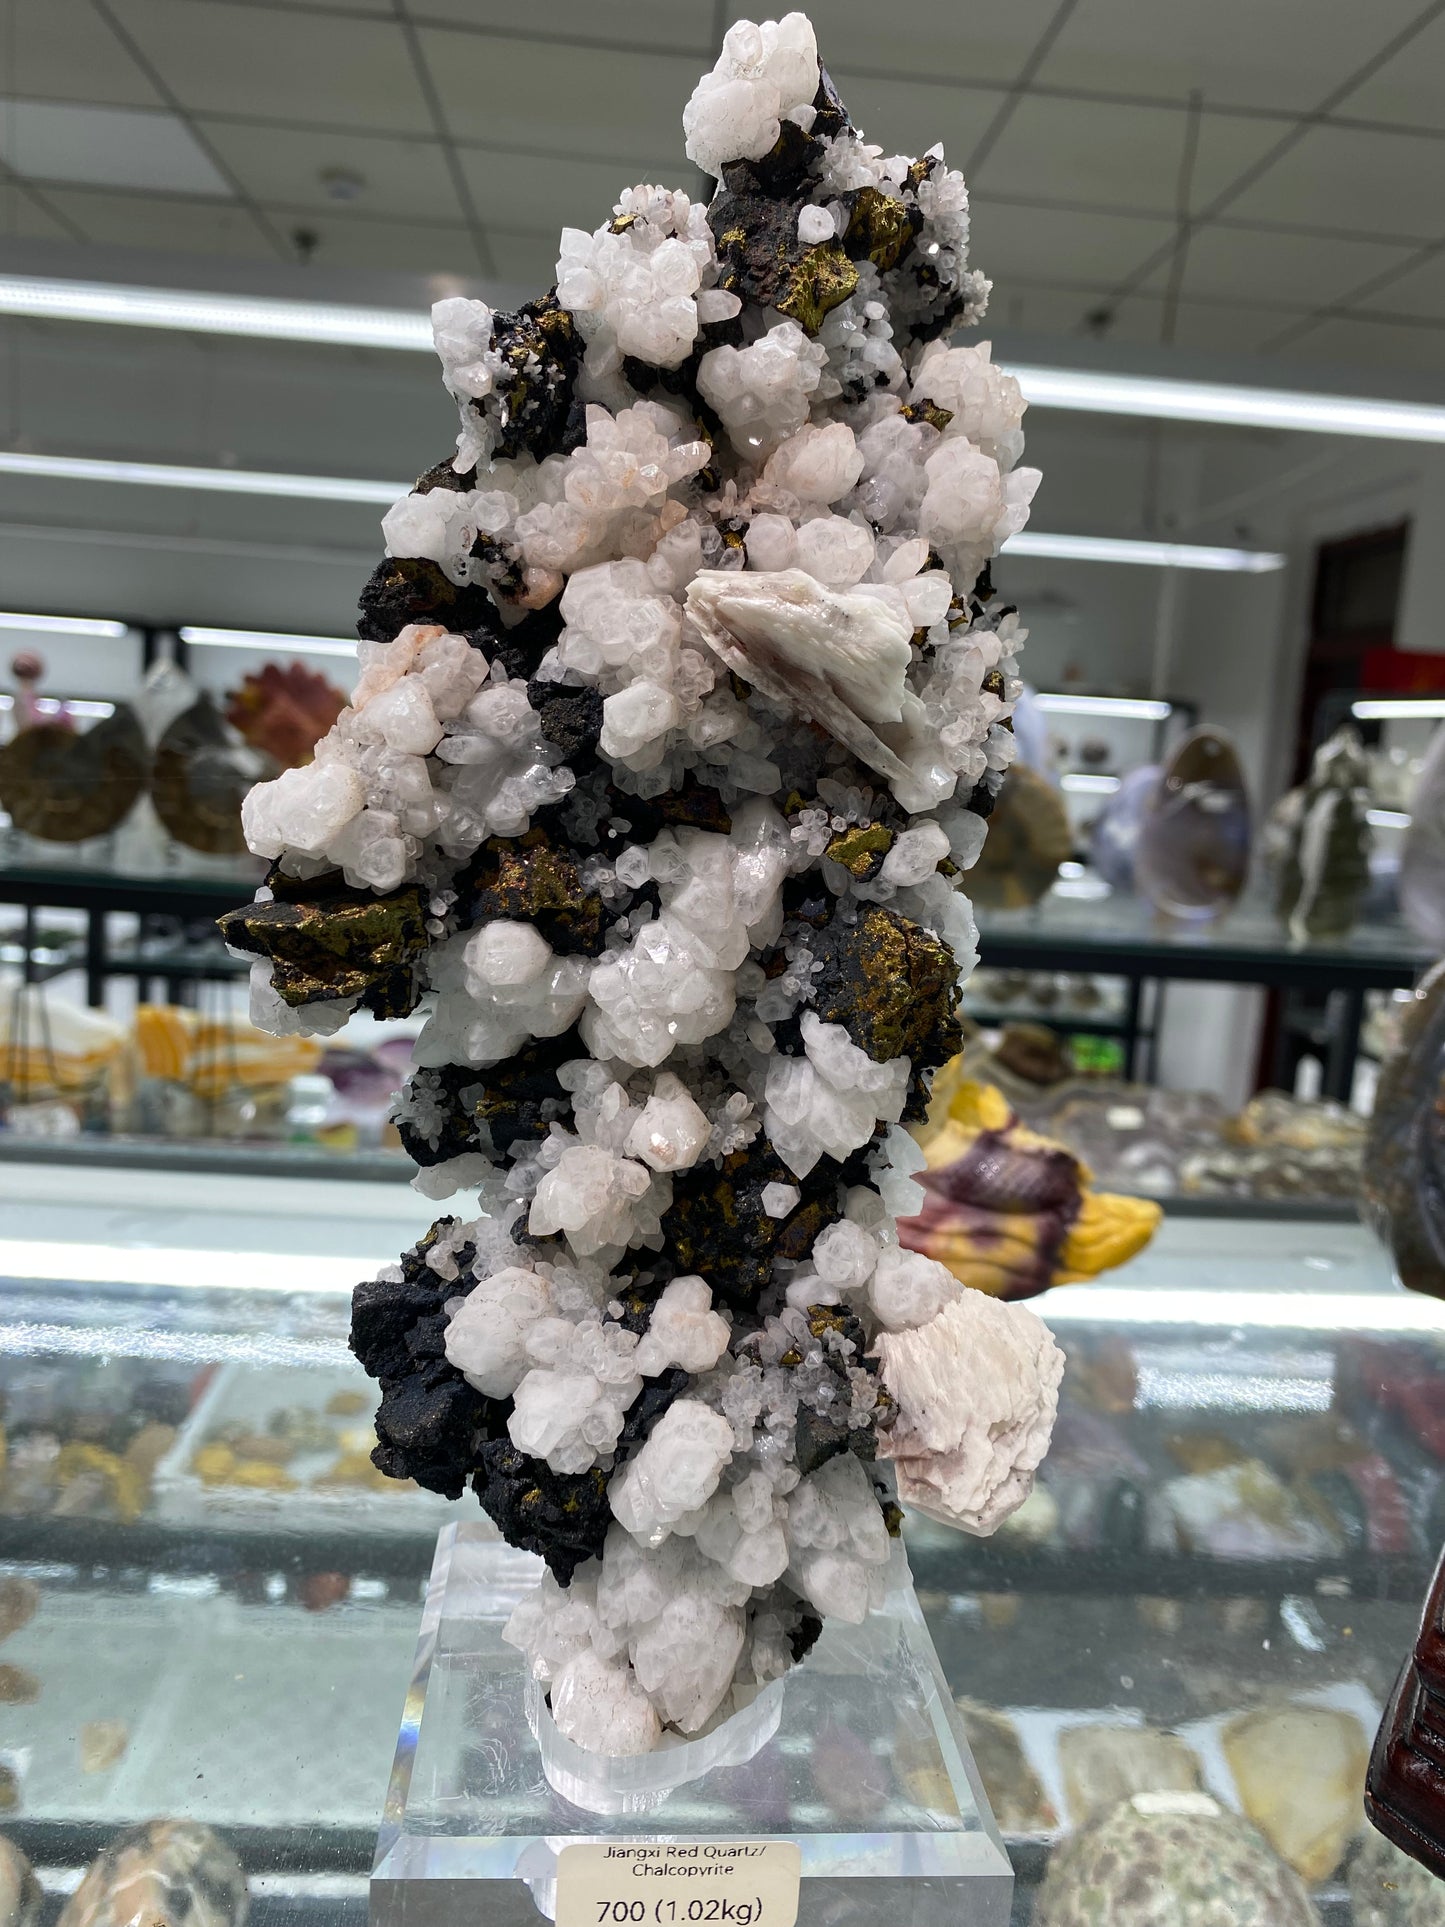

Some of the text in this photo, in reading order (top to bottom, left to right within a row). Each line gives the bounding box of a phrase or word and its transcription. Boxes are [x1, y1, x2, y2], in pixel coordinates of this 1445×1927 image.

[603, 1846, 660, 1861] Jiangxi
[667, 1846, 698, 1858] Red
[632, 1863, 734, 1877] Chalcopyrite
[596, 1897, 763, 1926] 700 (1.02kg)
